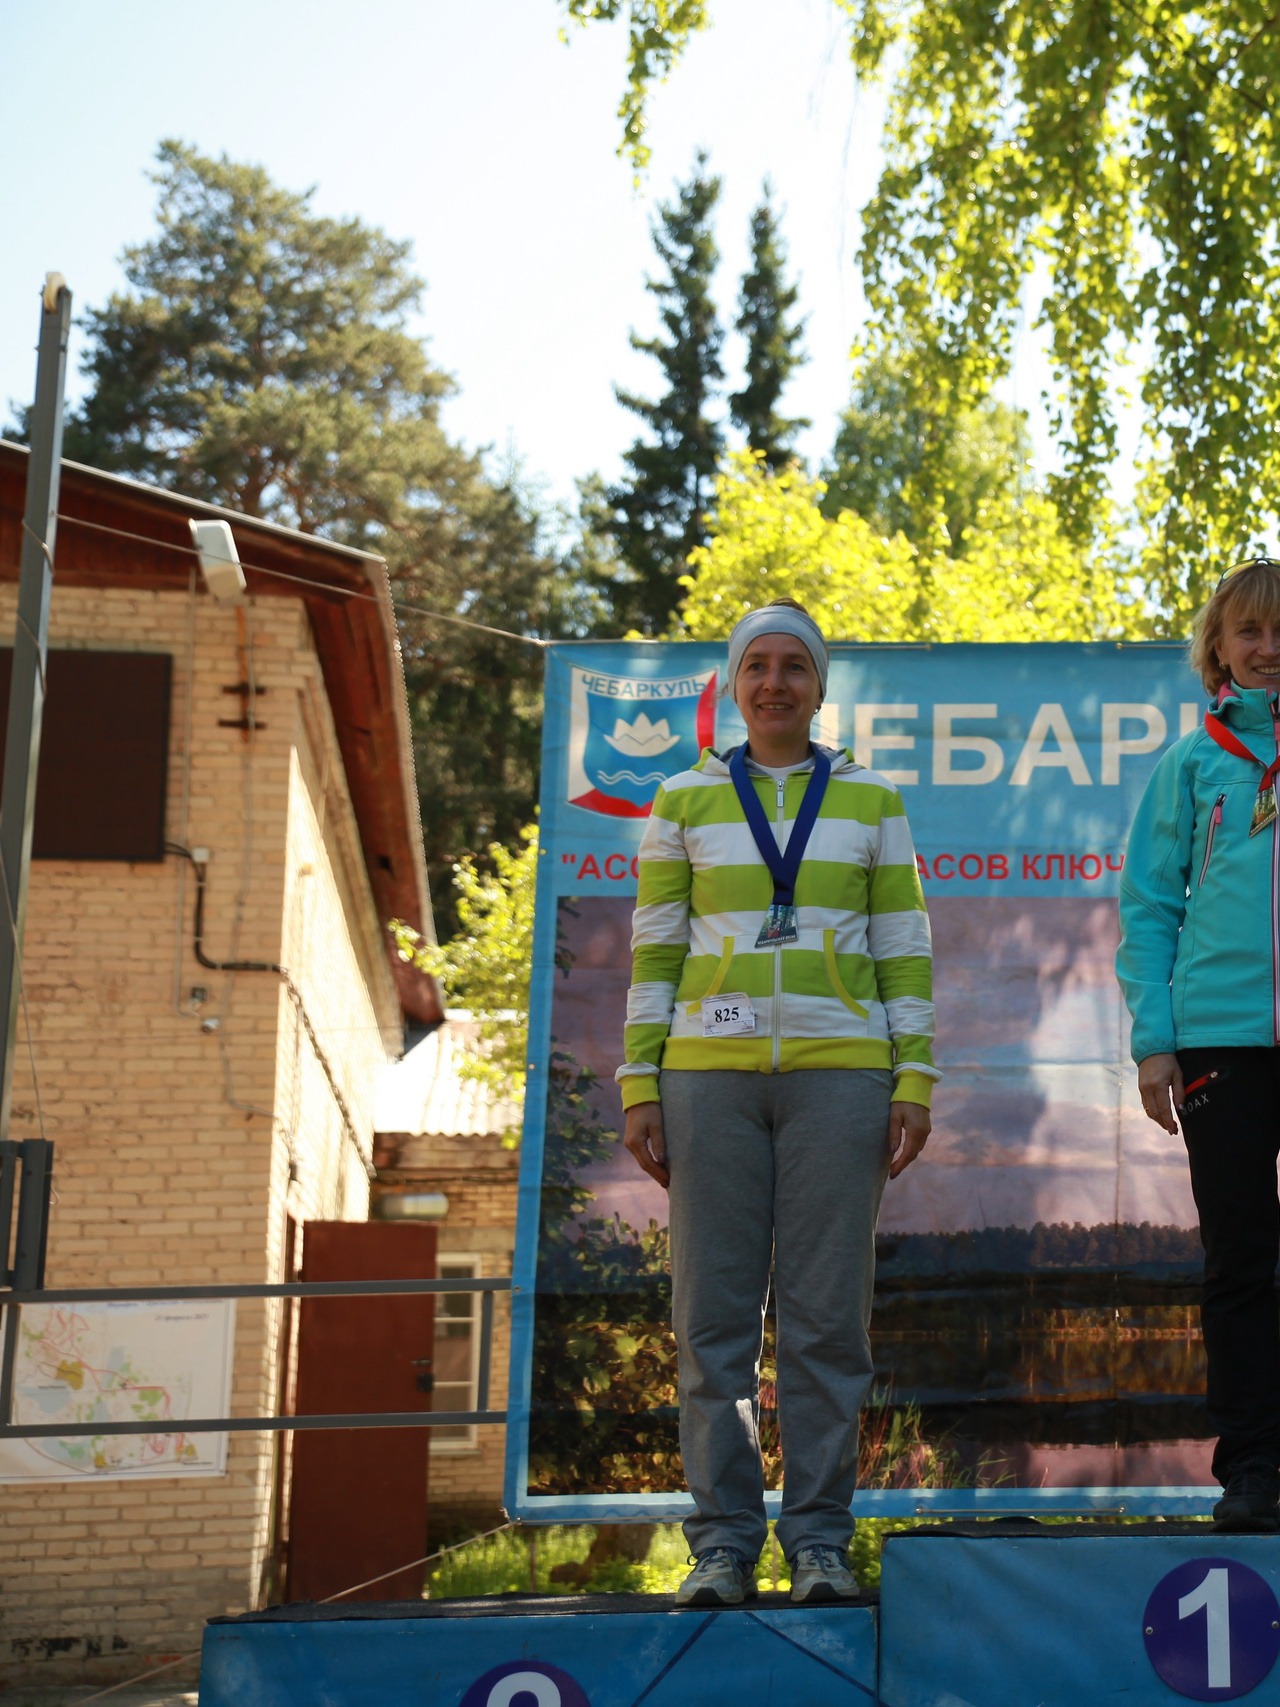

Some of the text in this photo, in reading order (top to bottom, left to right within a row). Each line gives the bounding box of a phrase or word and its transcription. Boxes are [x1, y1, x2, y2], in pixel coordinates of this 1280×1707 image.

[582, 674, 707, 697] ЧЕБАРКУЛЬ
[1022, 854, 1125, 880] КЛЮЧ
[714, 1006, 740, 1024] 825
[1178, 1567, 1231, 1688] 1
